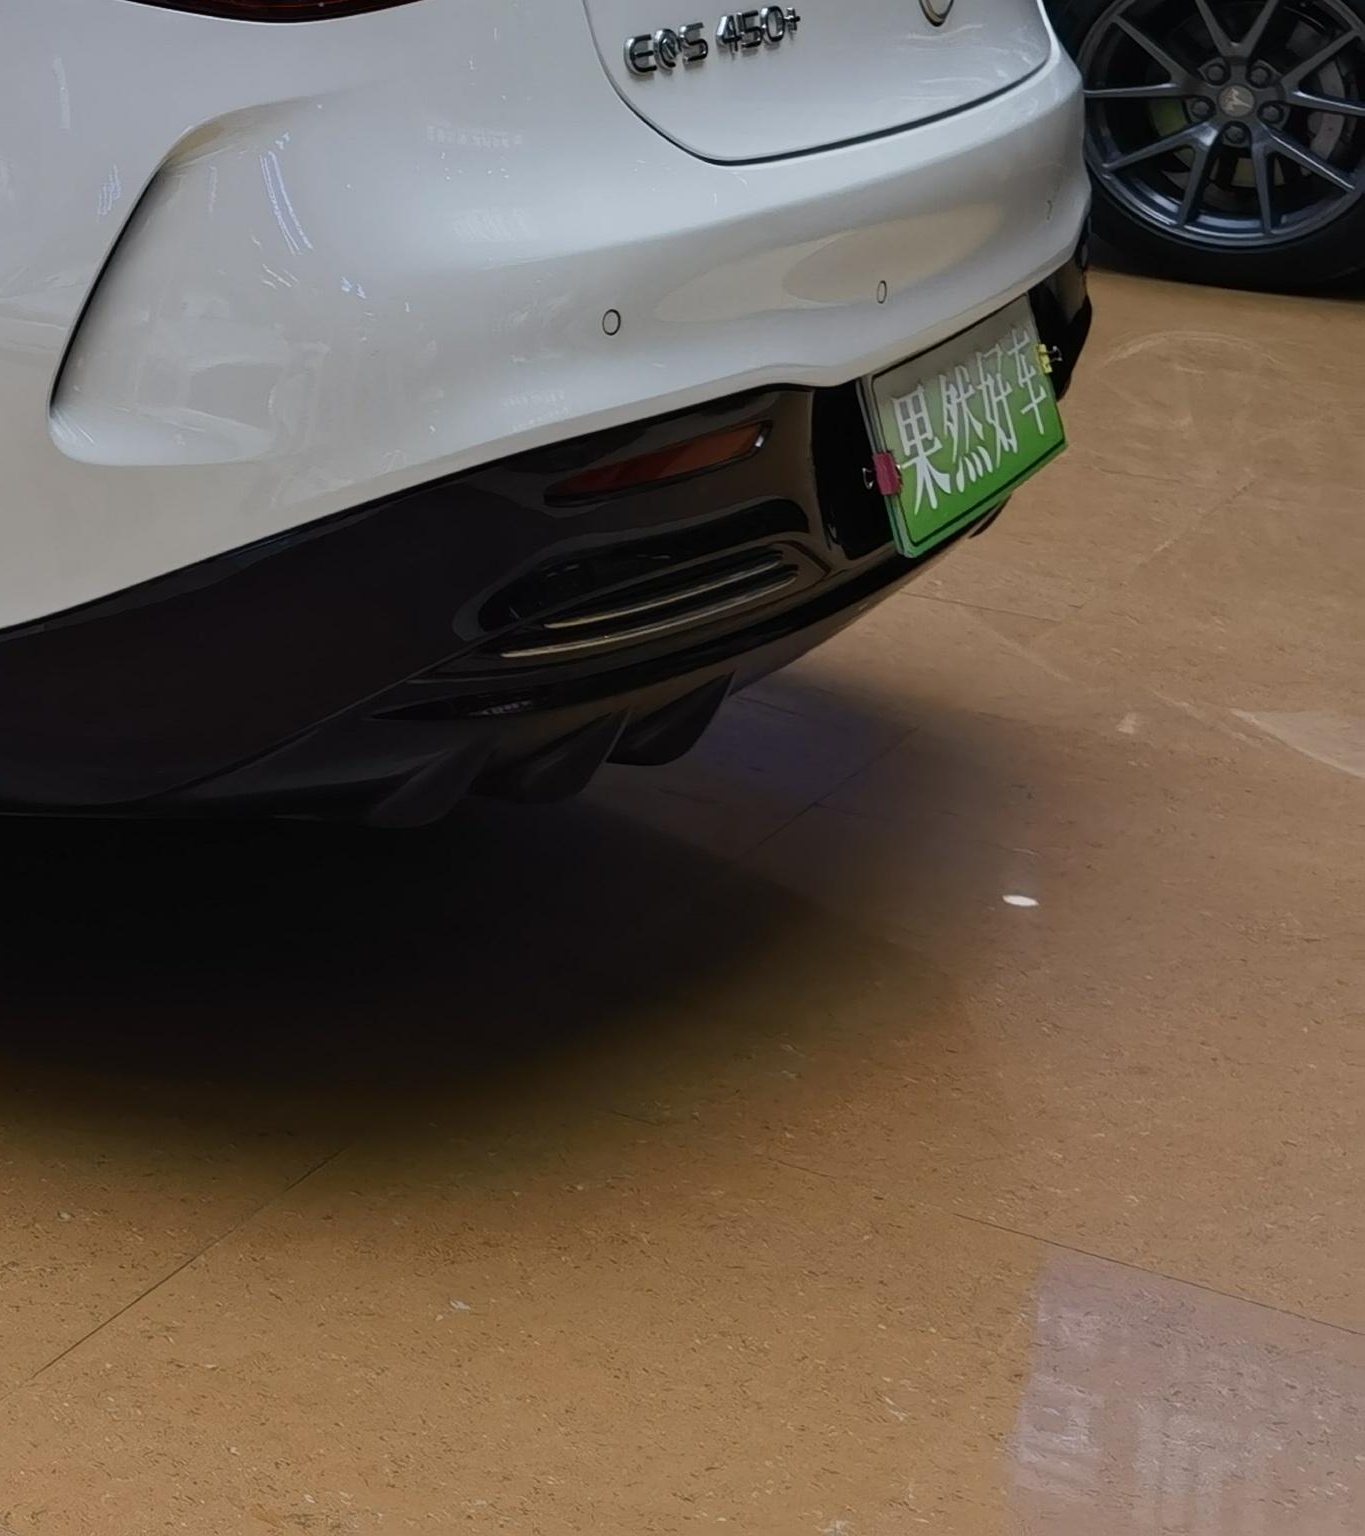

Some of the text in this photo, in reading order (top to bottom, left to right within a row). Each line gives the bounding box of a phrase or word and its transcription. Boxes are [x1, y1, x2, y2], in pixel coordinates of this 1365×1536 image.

[715, 4, 802, 58] 450+
[892, 329, 1047, 517] 果然好车
